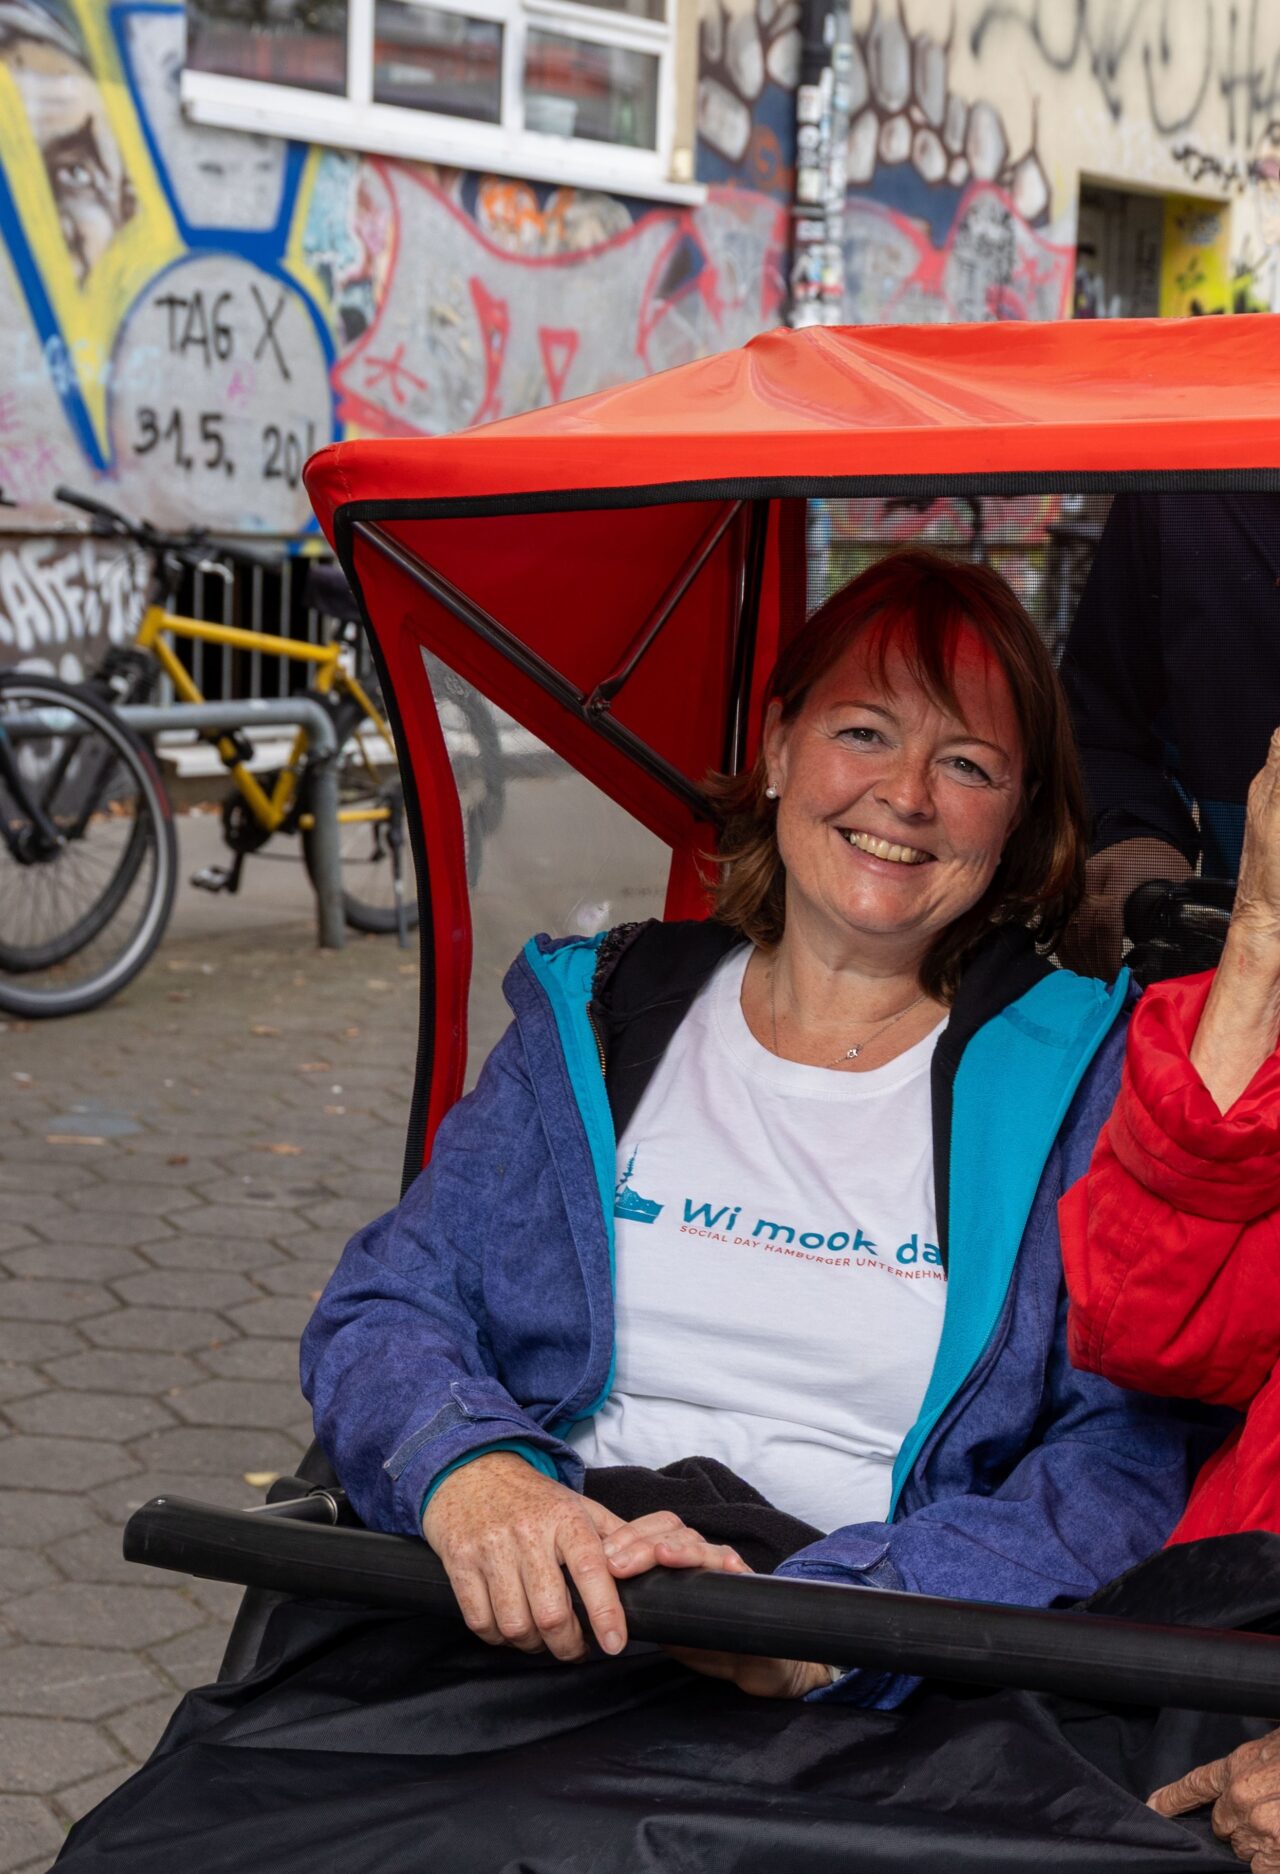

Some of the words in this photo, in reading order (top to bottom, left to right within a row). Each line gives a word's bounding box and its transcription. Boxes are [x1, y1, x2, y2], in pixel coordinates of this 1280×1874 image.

[252, 283, 290, 381] X
[679, 1225, 729, 1243] SOCIAL
[733, 1236, 761, 1249] DAY
[764, 1243, 851, 1267] HAMBURGER
[683, 1198, 742, 1231] Wi
[751, 1219, 879, 1257] mook
